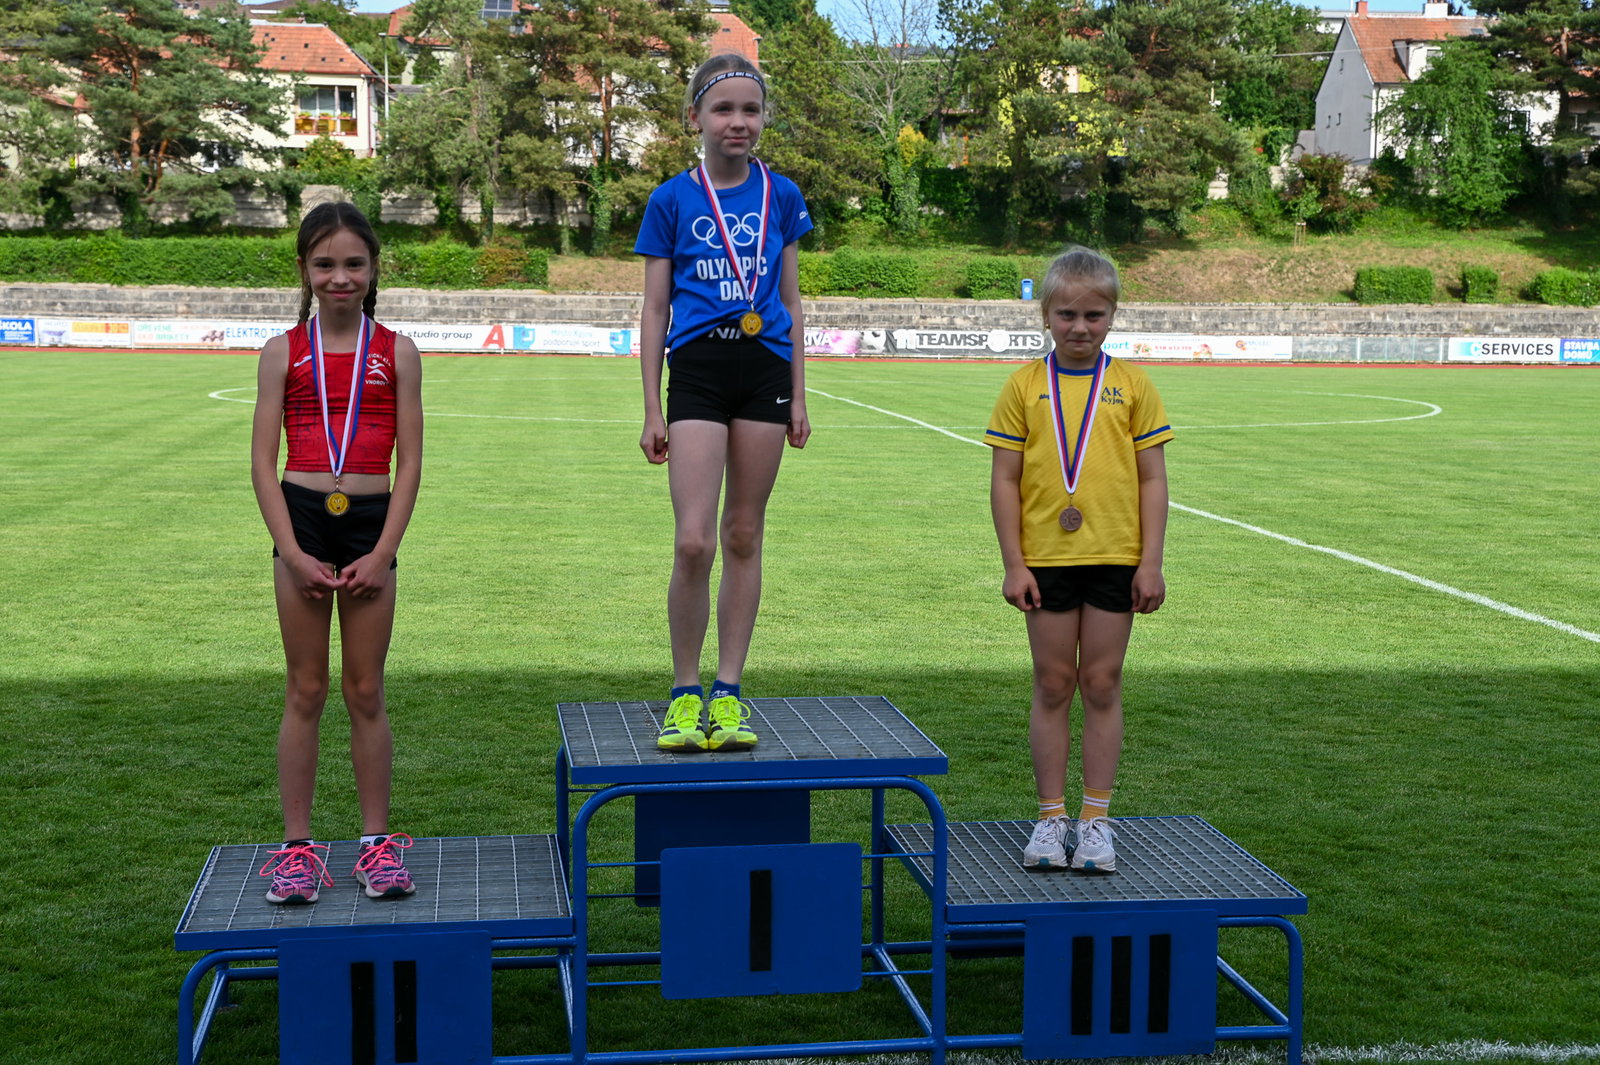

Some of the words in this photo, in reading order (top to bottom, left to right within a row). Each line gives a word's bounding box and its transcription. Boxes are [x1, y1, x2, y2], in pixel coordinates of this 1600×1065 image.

[226, 327, 267, 339] ELEKTRO
[407, 330, 440, 339] studio
[441, 331, 473, 340] group
[1481, 343, 1554, 356] SERVICES
[1563, 341, 1600, 351] STAVBA
[1102, 387, 1123, 398] AK
[1101, 396, 1125, 405] Kyjov
